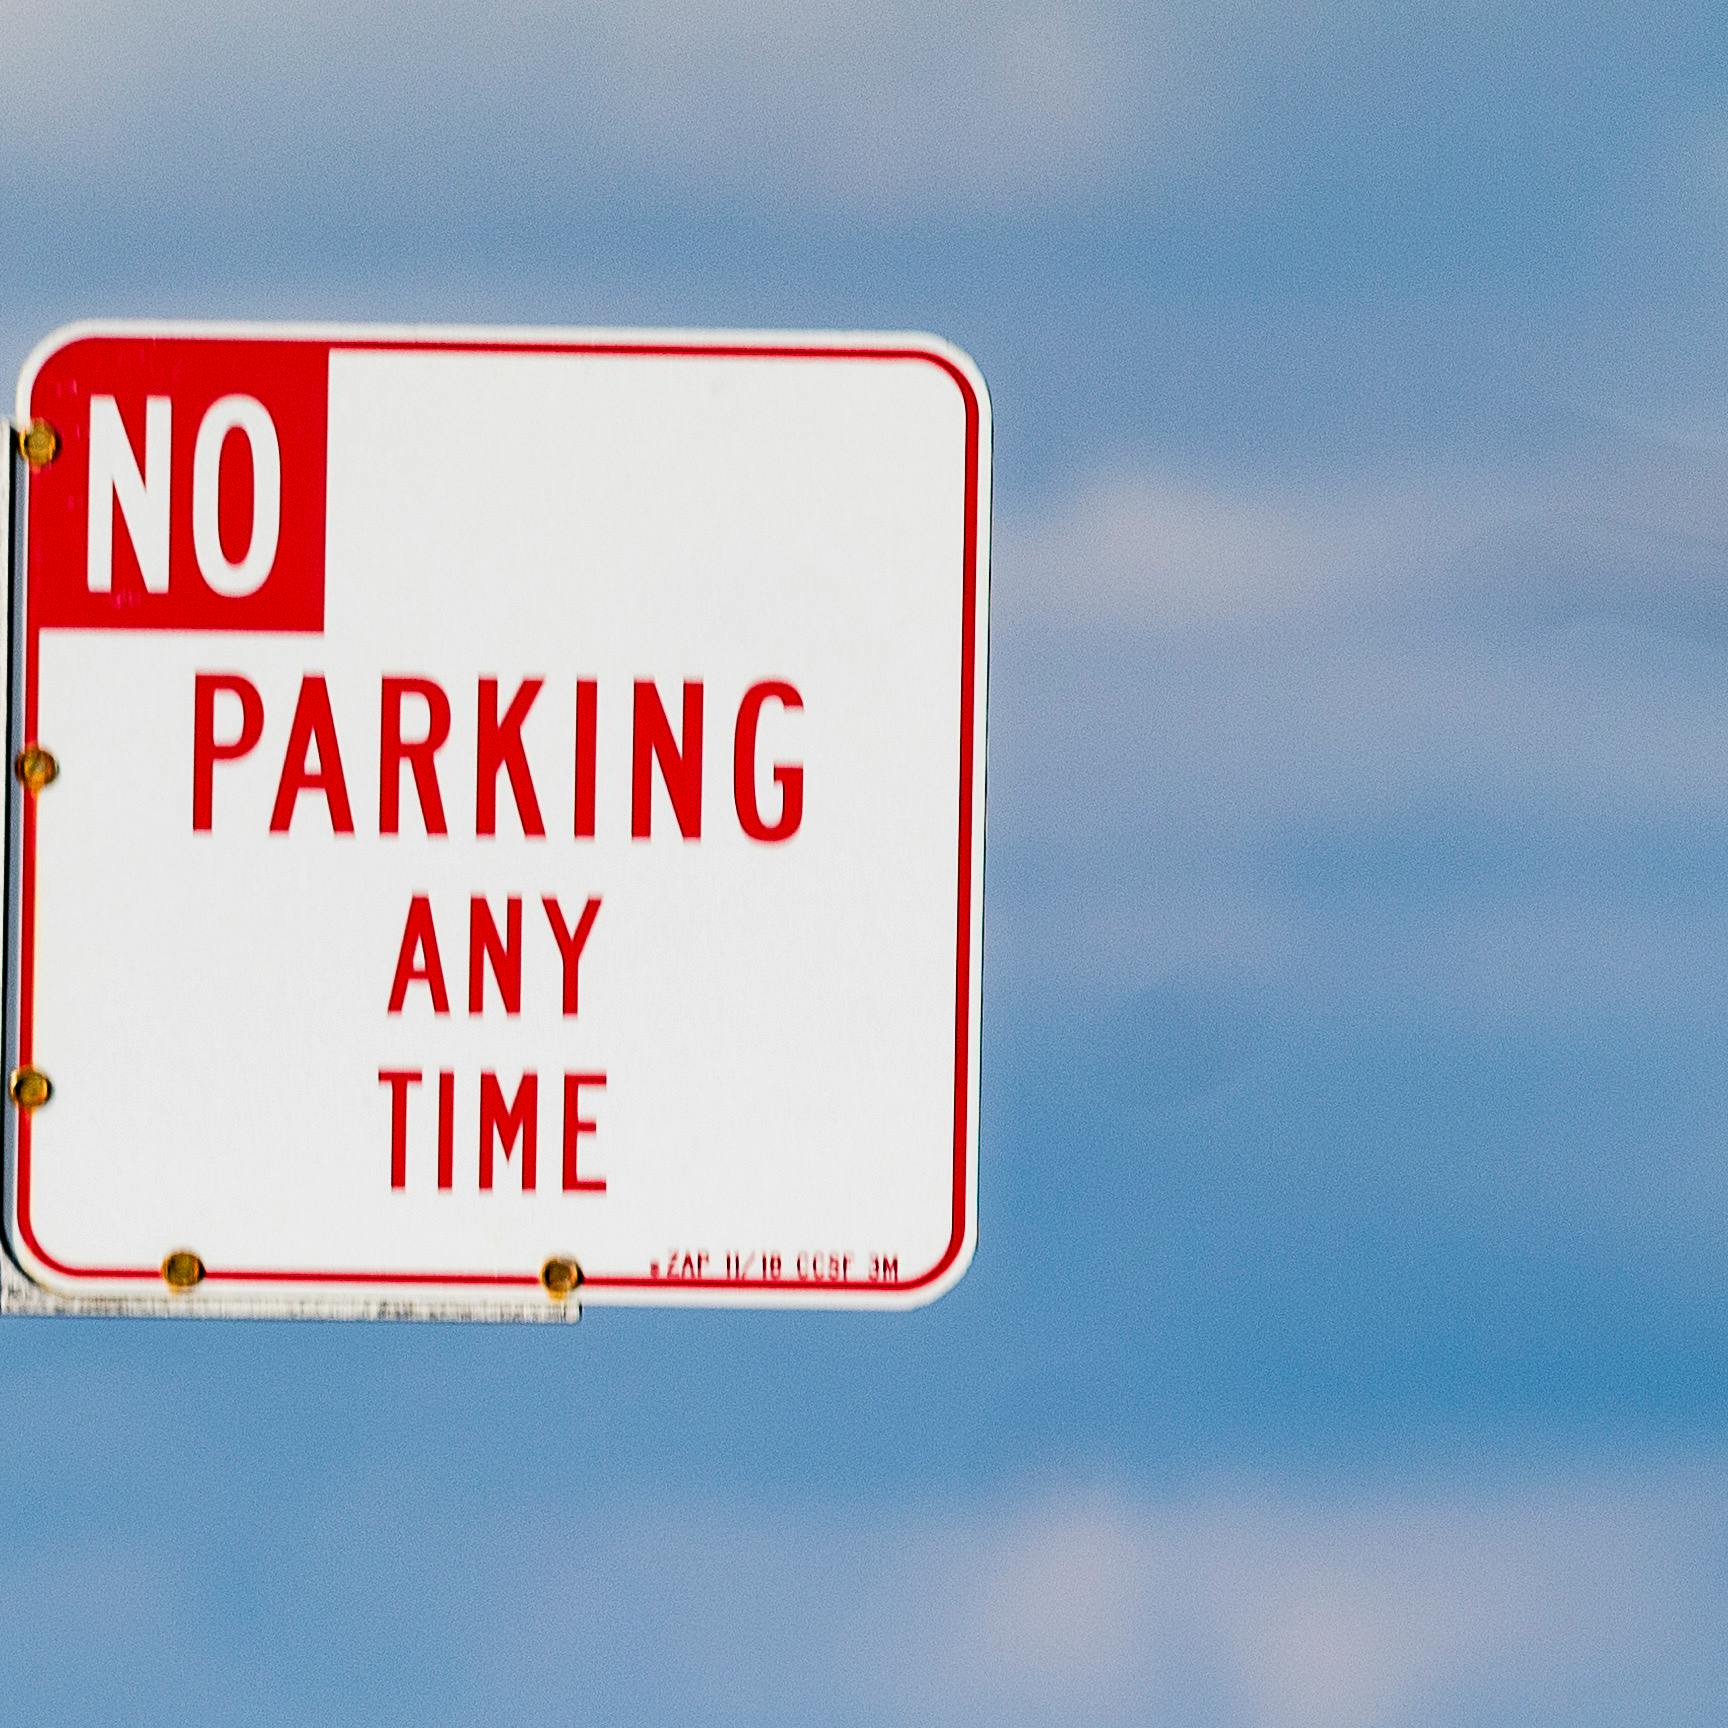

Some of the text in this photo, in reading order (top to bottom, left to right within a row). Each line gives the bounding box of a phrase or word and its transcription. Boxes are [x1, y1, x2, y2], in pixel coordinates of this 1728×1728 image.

[86, 394, 282, 598] NO
[191, 670, 805, 846] PARKING
[386, 892, 603, 1018] ANY
[376, 1067, 609, 1195] TIME
